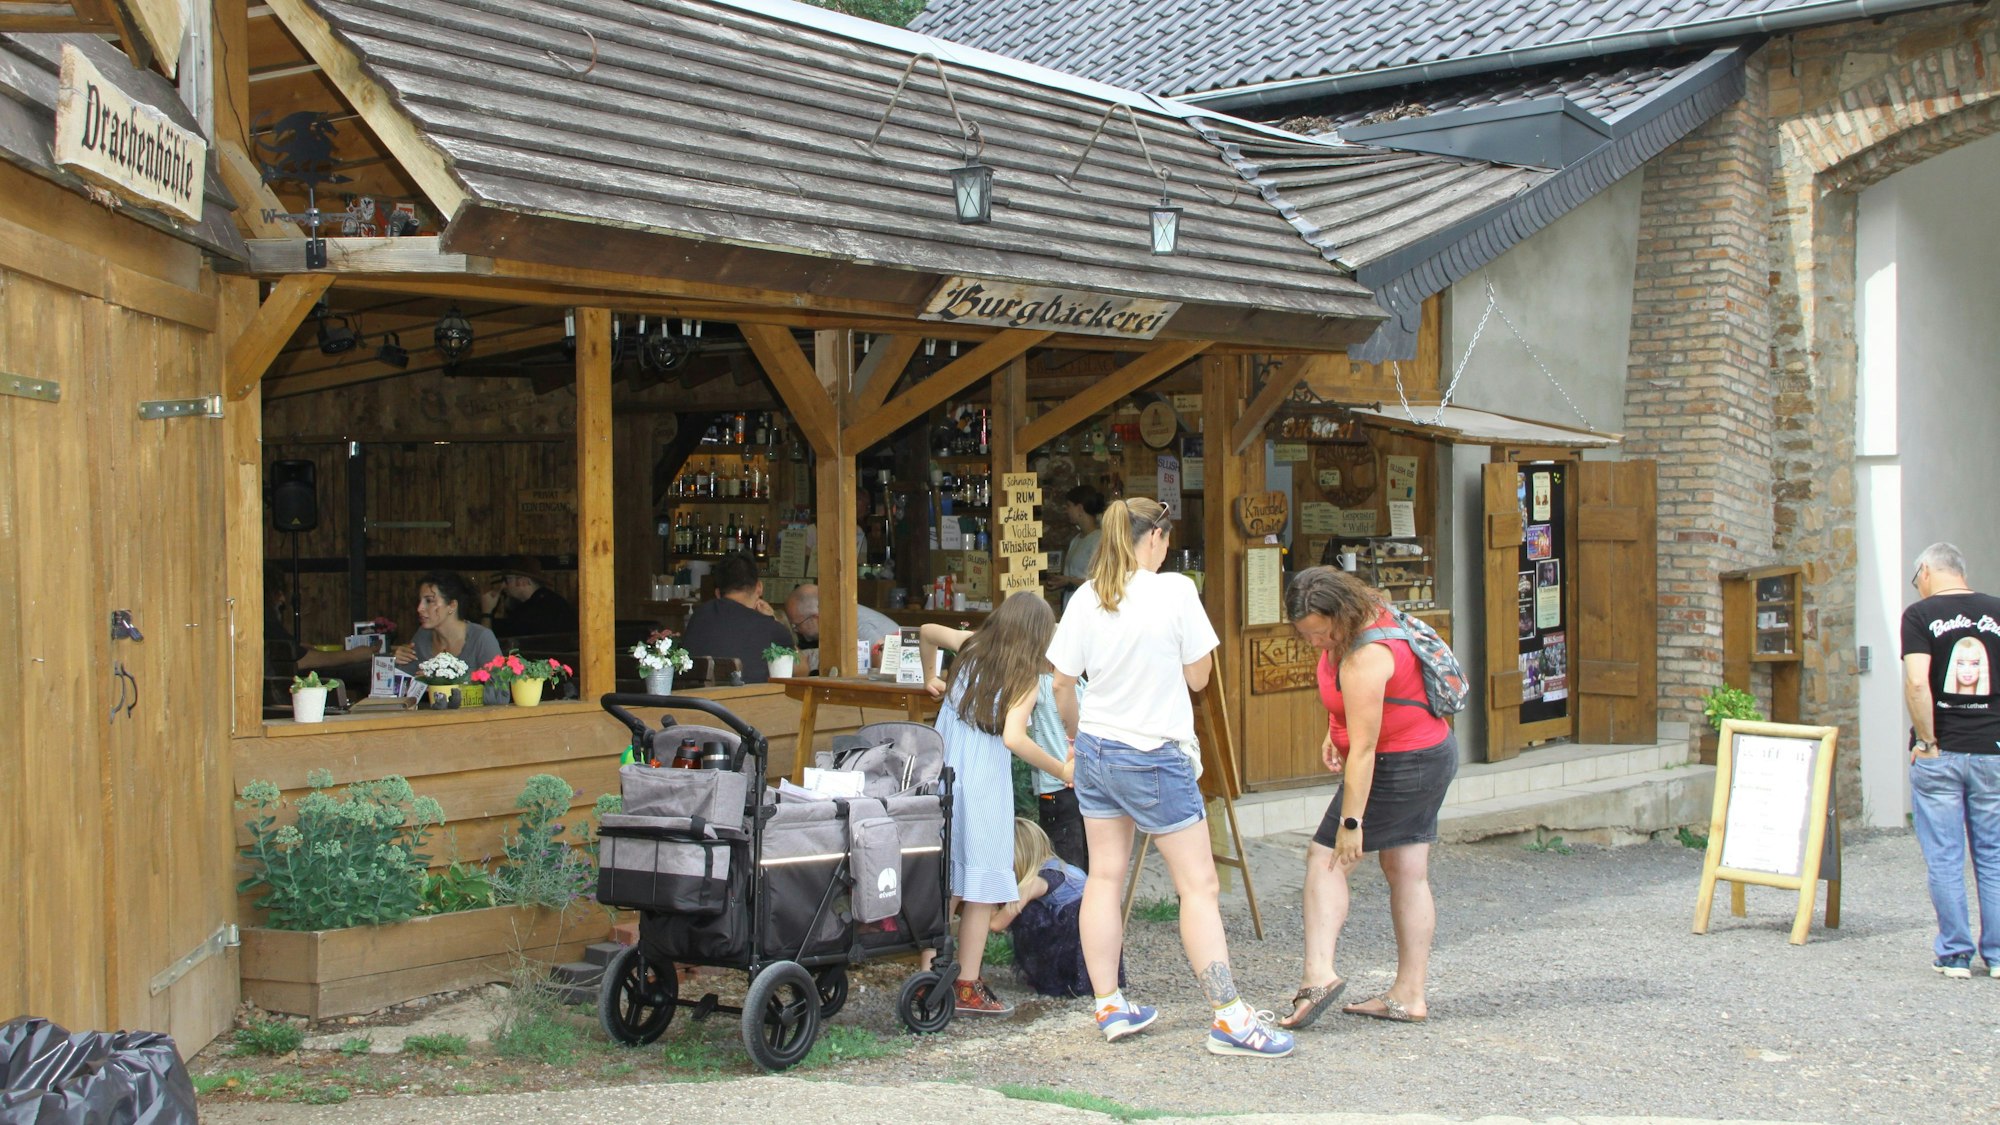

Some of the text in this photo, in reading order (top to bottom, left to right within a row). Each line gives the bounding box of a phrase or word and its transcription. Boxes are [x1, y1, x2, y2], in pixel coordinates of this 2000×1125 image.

[81, 79, 193, 204] Drachenhöhle
[937, 281, 1167, 331] Burgbäckerei
[1006, 475, 1035, 488] Schnaps
[1016, 491, 1035, 503] RUM
[1004, 507, 1028, 523] Likör
[1012, 523, 1037, 539] Vodka
[1001, 540, 1037, 554] Whiskey
[1021, 556, 1037, 571] Gin
[1006, 574, 1035, 588] Absinth
